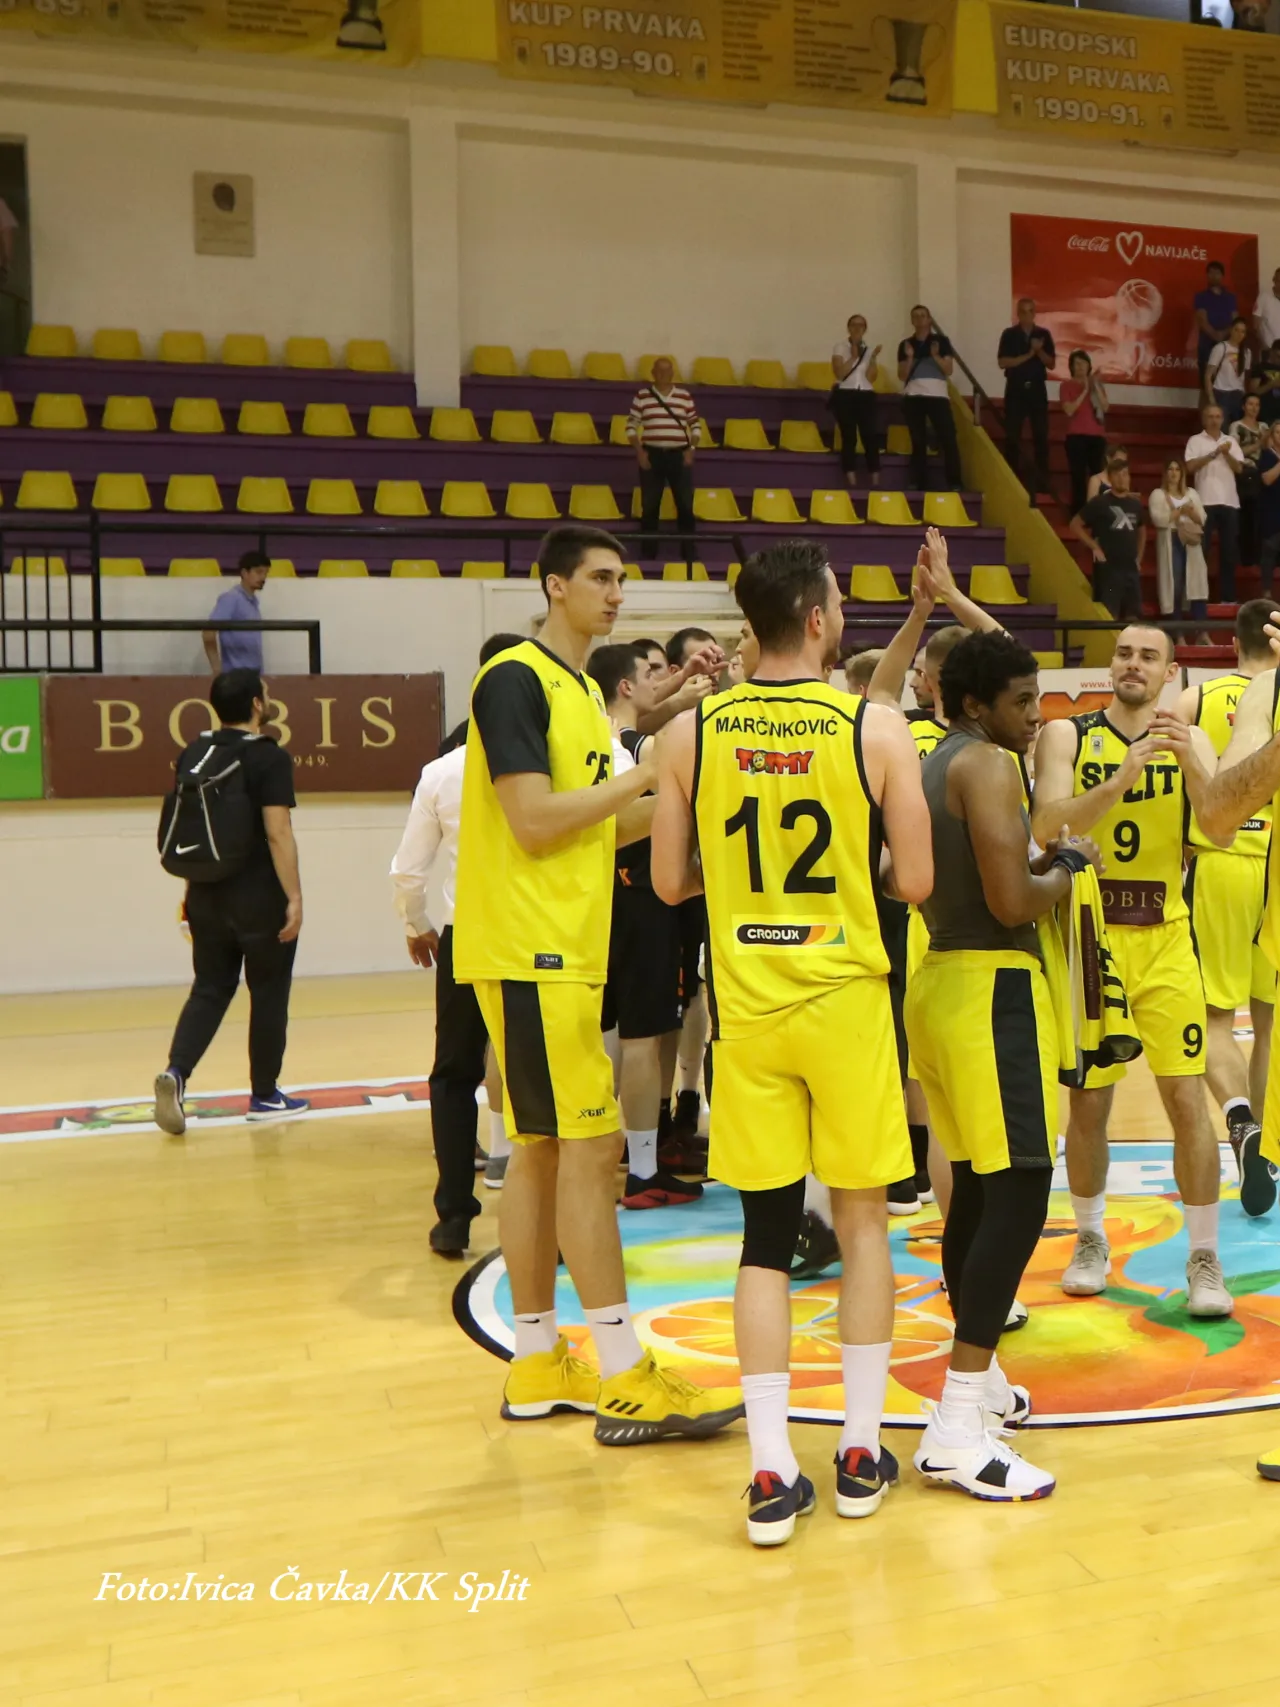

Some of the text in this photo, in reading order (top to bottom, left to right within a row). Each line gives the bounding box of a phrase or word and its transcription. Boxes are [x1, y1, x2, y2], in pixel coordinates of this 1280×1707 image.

[508, 2, 706, 41] KUP PRVAKA
[541, 42, 681, 78] 1989-90.
[1003, 25, 1138, 60] EUROPSKI
[1005, 58, 1172, 95] KUP PRVAKA
[1034, 97, 1146, 128] 1990-91.
[1145, 244, 1207, 261] NAVIJAČE
[1080, 680, 1113, 689] www.t
[735, 747, 815, 775] TOMMY
[724, 796, 837, 894] 12
[1113, 820, 1141, 862] 9
[1101, 890, 1164, 909] OBIS
[747, 928, 800, 941] CRODUX
[1182, 1023, 1203, 1058] 9
